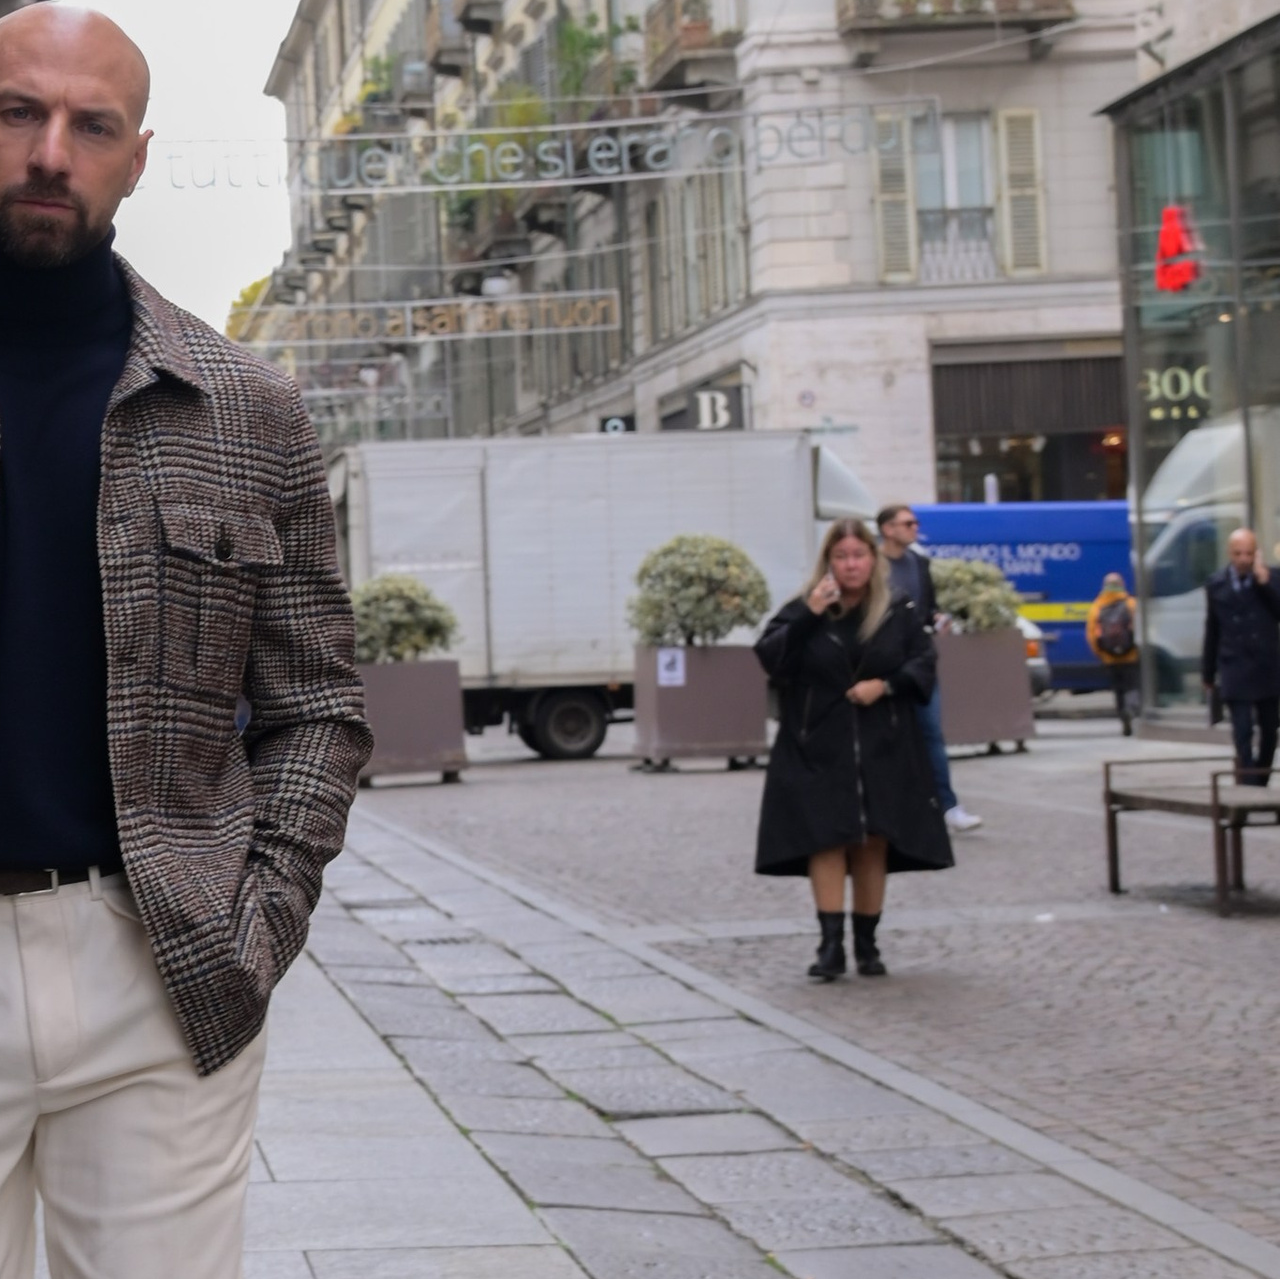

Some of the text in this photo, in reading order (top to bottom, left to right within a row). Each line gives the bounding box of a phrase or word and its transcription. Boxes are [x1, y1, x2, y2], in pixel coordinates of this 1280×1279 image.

[430, 130, 525, 184] che
[696, 390, 731, 430] B
[1016, 542, 1082, 561] MONDO
